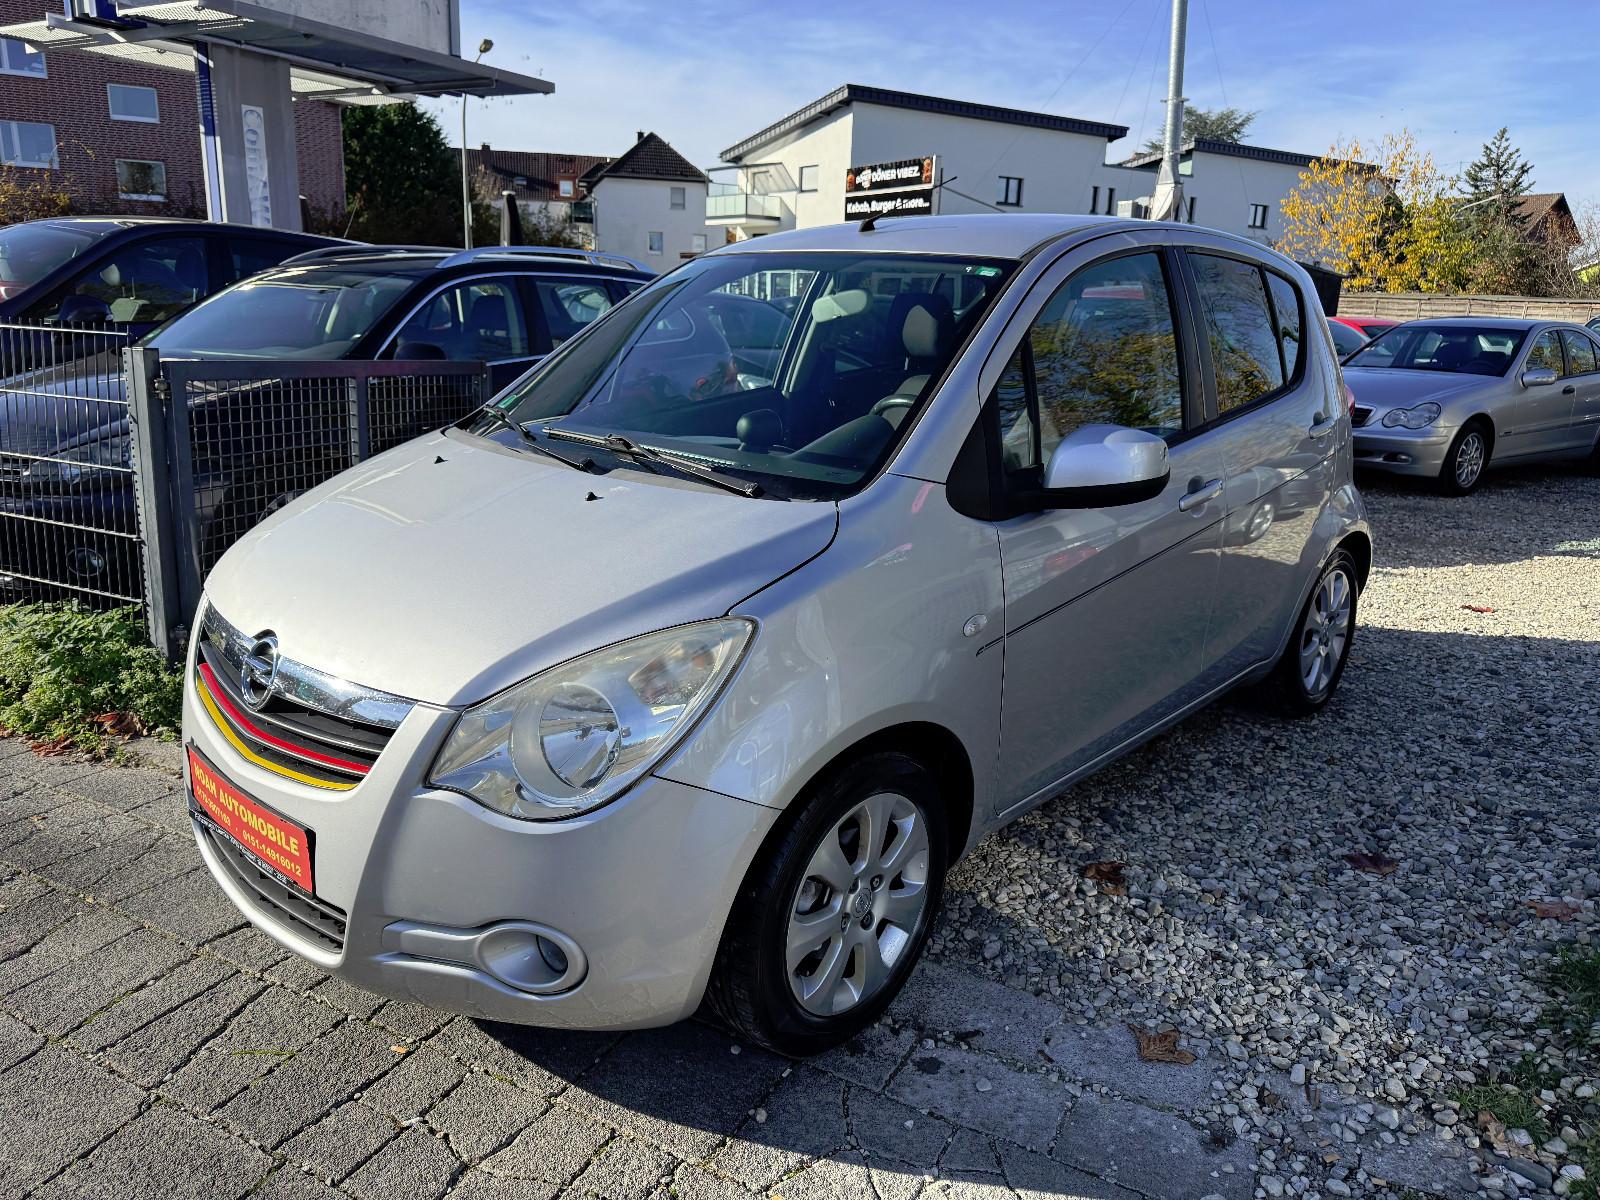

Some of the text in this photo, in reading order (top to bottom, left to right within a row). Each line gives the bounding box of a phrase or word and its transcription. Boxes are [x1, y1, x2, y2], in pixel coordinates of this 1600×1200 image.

[870, 200, 896, 213] Burger
[194, 762, 218, 798] NOAH
[220, 788, 300, 856] AUTOMOBILE
